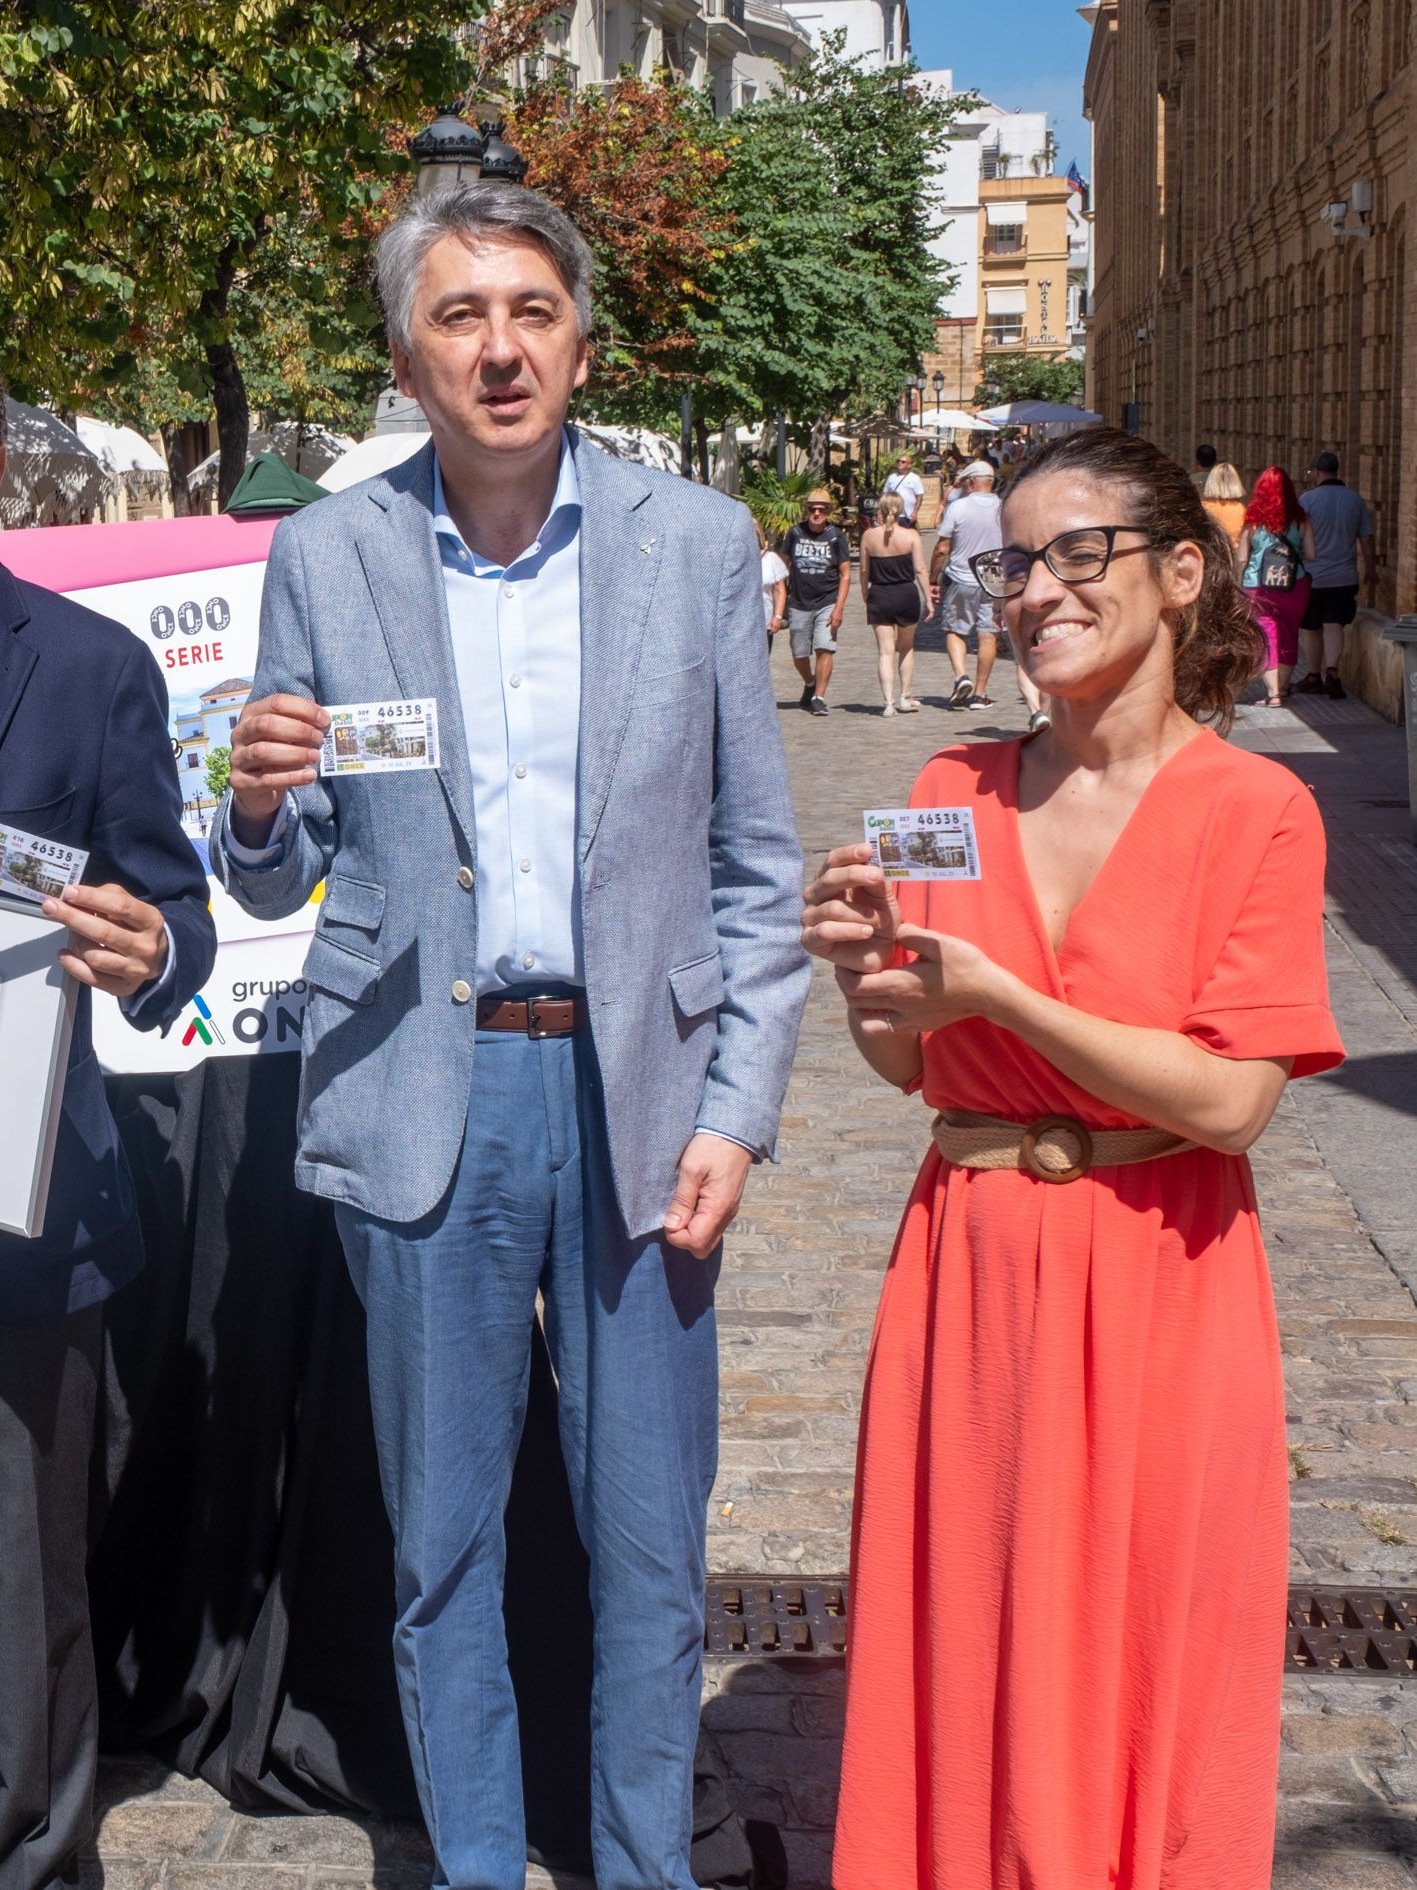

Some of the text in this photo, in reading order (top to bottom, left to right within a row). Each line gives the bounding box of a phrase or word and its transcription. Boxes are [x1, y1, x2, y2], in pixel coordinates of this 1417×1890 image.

[795, 543, 832, 558] BEETLE
[151, 606, 164, 622] ONCE
[179, 602, 192, 618] ONCE
[206, 598, 219, 614] ONCE
[150, 597, 231, 640] 000
[189, 618, 202, 634] ONCE
[216, 614, 229, 630] ONCE
[162, 622, 174, 638] ONCE
[165, 642, 224, 668] SERIE
[377, 705, 422, 717] 46538
[918, 813, 960, 825] 46538
[30, 841, 73, 862] 46538
[232, 979, 308, 1002] grupo
